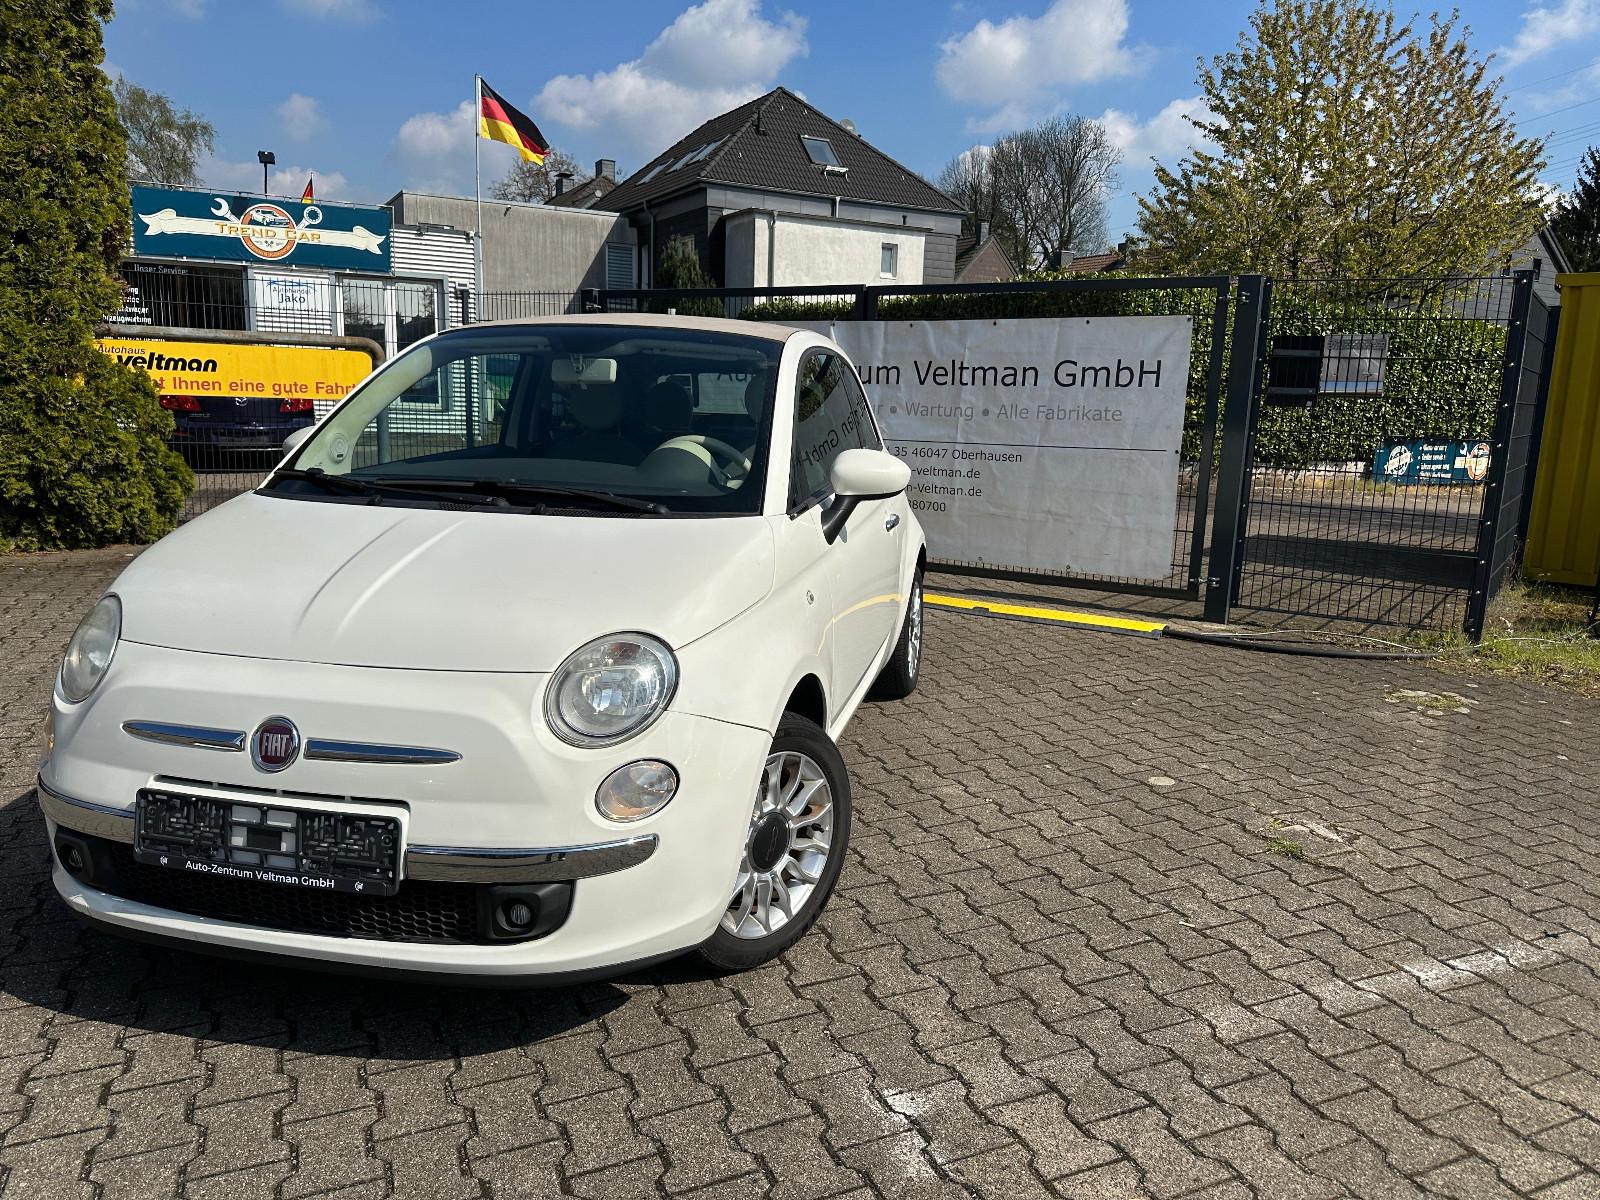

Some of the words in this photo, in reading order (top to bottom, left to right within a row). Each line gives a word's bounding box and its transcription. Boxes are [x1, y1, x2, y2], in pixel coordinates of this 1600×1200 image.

[215, 222, 277, 238] TREND
[285, 228, 326, 242] CAR
[279, 293, 306, 303] Jako
[97, 344, 146, 355] Autohaus
[116, 352, 218, 373] veltman
[913, 359, 1039, 387] Veltman
[1053, 358, 1162, 388] GmbH
[173, 377, 222, 391] Ihnen
[229, 379, 265, 392] eine
[272, 382, 308, 396] gute
[905, 402, 974, 421] Wartung
[996, 403, 1029, 420] Alle
[1036, 405, 1122, 422] Fabrikate
[893, 447, 908, 457] 35
[911, 448, 948, 459] 46047
[951, 449, 1022, 463] Oberhausen
[262, 732, 290, 757] FIAT
[185, 860, 253, 879] Auto-Zentrum
[255, 870, 299, 885] Veltman
[301, 876, 335, 889] GmbH
